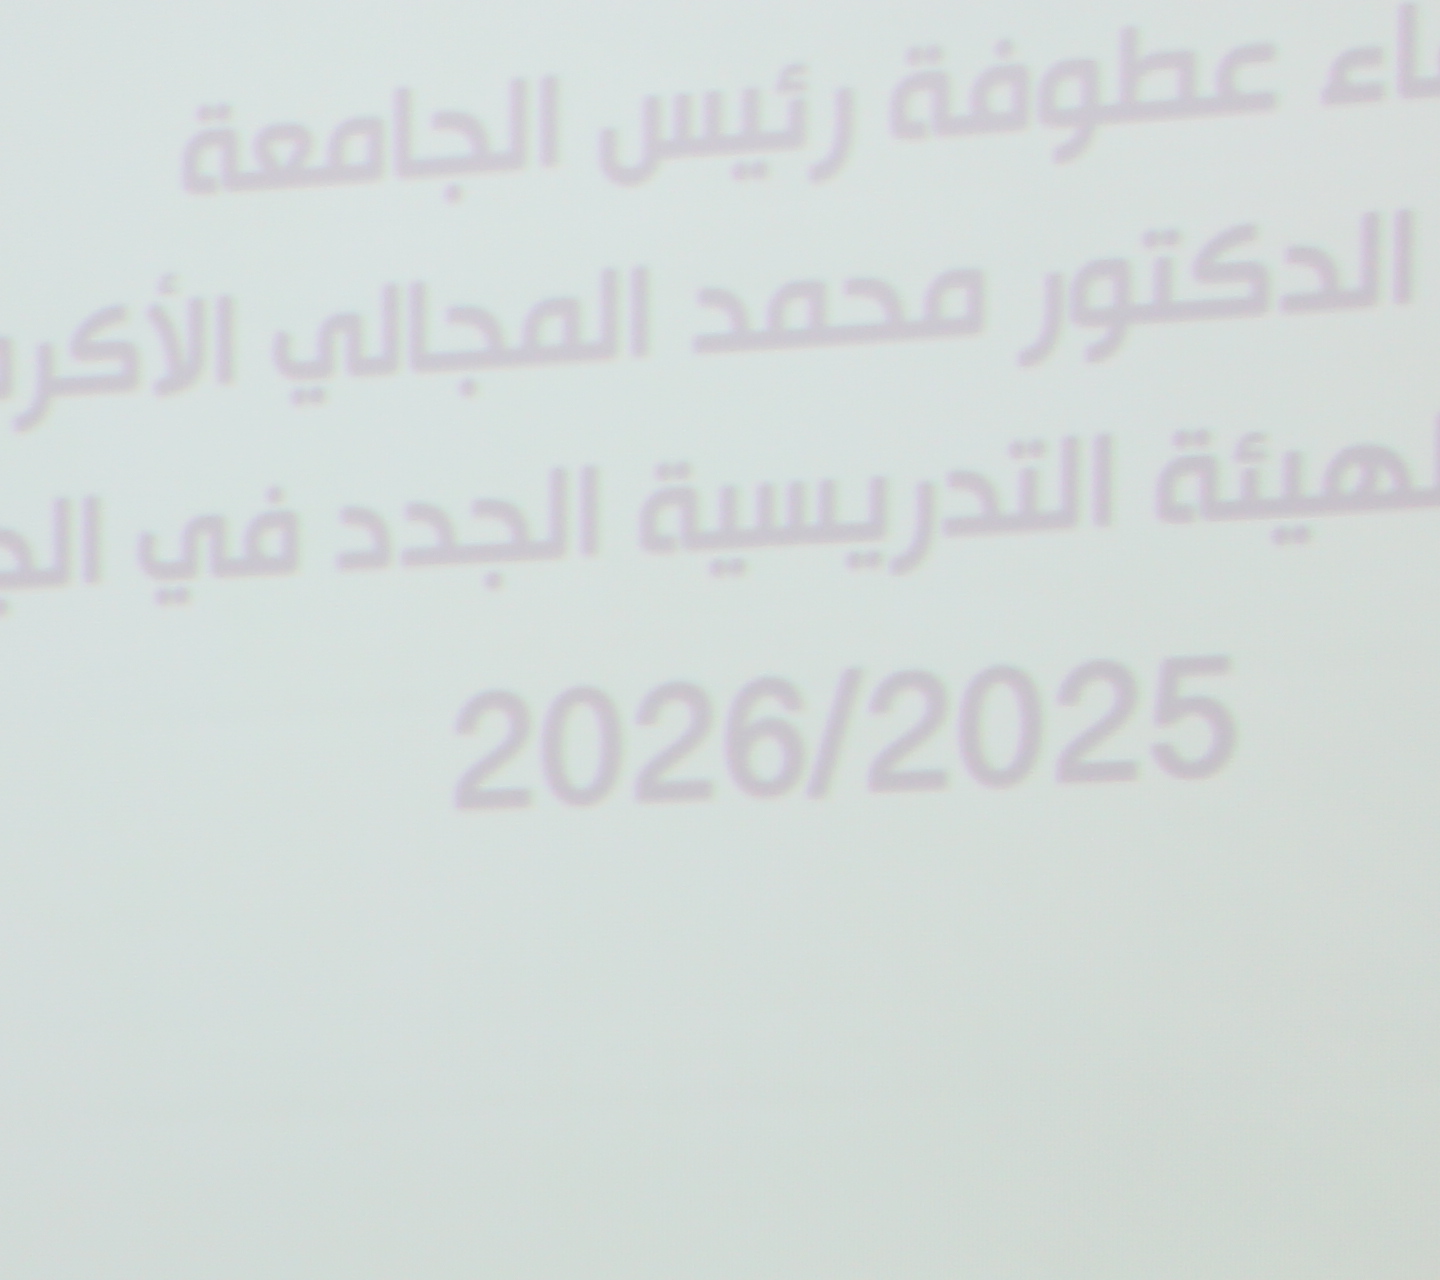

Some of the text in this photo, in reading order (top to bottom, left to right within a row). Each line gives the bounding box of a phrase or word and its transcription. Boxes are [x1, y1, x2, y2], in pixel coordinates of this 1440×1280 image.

[178, 72, 562, 206] الجامعة
[596, 59, 857, 191] رئيس
[885, 23, 1279, 168] عطوفة
[269, 263, 651, 410] المجالي
[689, 265, 988, 357] محمد
[1014, 206, 1417, 371] الدكتور
[133, 482, 303, 611] في
[331, 463, 602, 594] الجدد
[636, 431, 1114, 580] التدريسية
[451, 652, 1239, 815] 2026/2025
